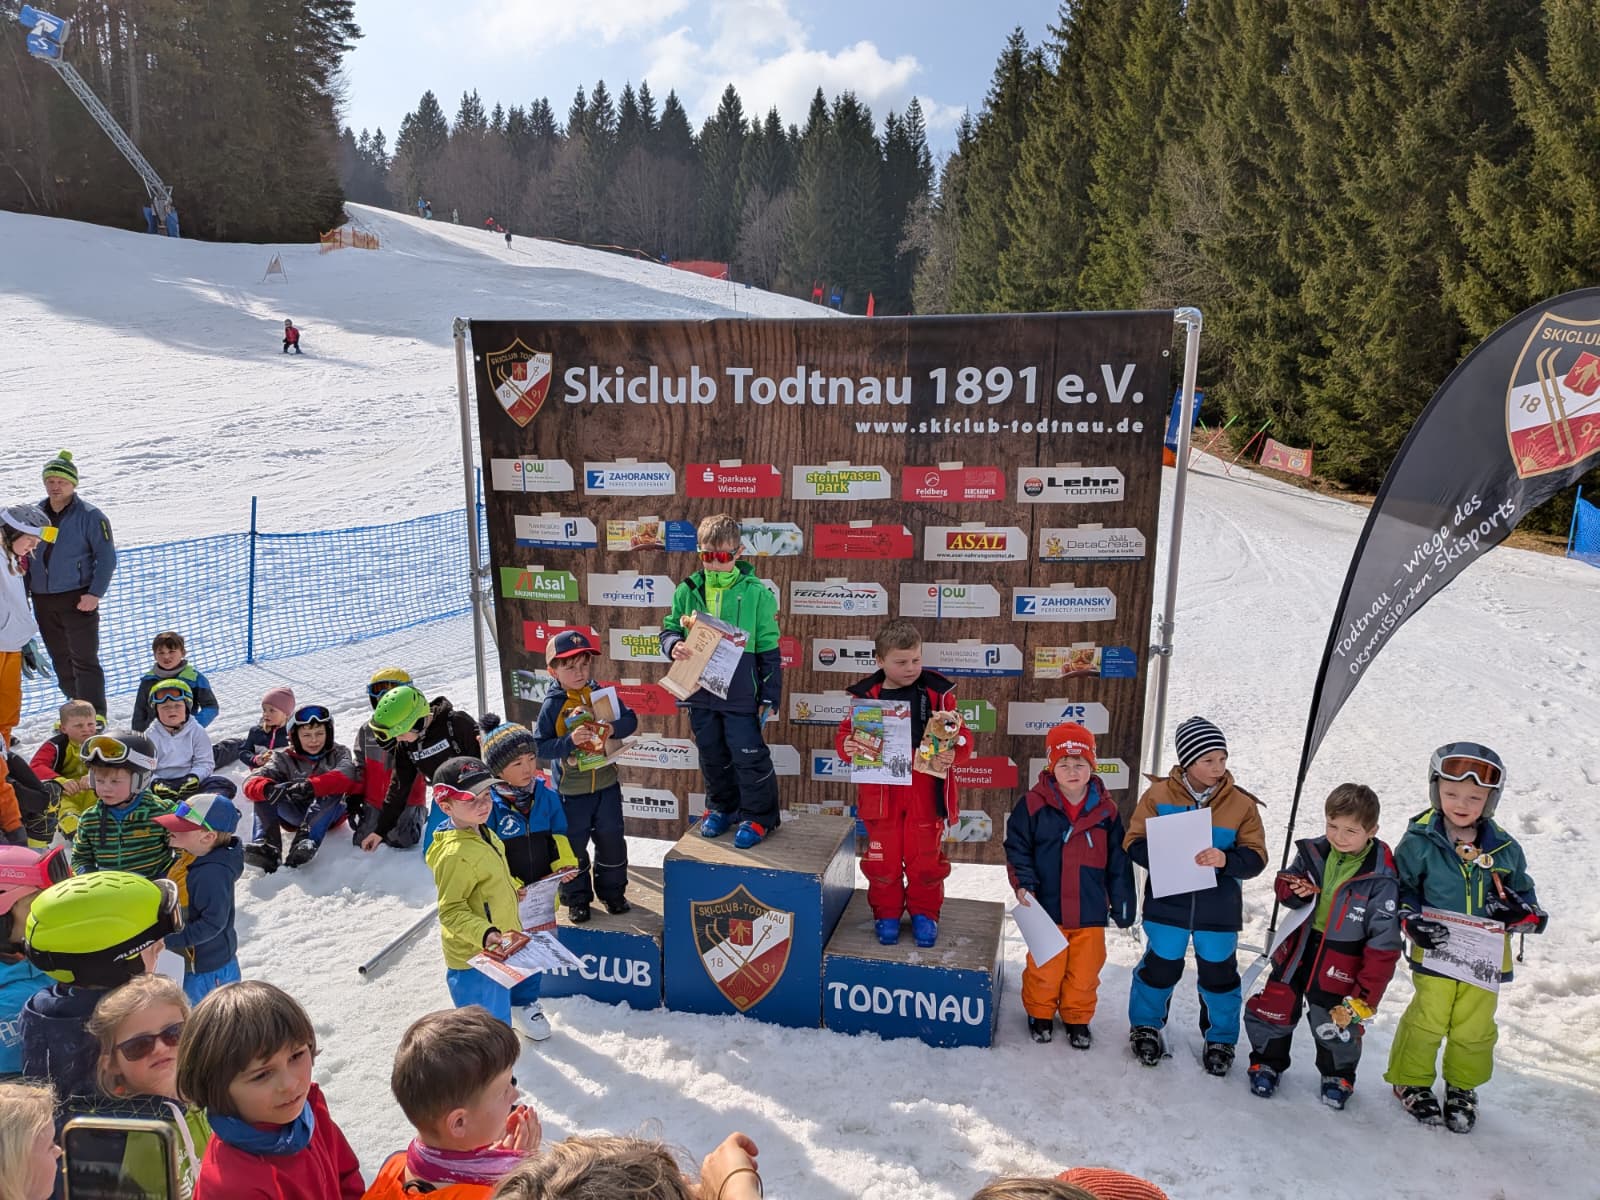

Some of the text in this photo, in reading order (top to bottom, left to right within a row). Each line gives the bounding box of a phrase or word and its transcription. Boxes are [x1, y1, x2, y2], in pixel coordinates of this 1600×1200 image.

[563, 363, 1145, 405] Skiclub Todtnau 1891 e.V.
[502, 389, 511, 399] 18
[1519, 393, 1542, 413] 18
[855, 417, 1145, 434] www.skiclub-todtnau.de
[608, 472, 671, 481] ZAHORANSKY
[717, 474, 757, 484] Sparkasse
[1047, 476, 1119, 487] Lehr
[717, 485, 757, 493] Wiesental
[815, 481, 849, 495] park
[915, 488, 948, 497] Feldberg
[949, 533, 1005, 549] ASAL
[1434, 497, 1516, 573] Skisports
[1066, 540, 1143, 549] DataCreate
[1335, 592, 1391, 658] Todtnau
[1454, 494, 1482, 527] des
[534, 575, 565, 591] Asal
[602, 591, 645, 603] engineering
[793, 591, 878, 599] TEICHMANN
[1041, 597, 1112, 606] ZAHORANSKY
[630, 644, 661, 657] park
[952, 766, 993, 774] Sparkasse
[631, 804, 675, 814] TODTNAU
[710, 957, 776, 975] 18 91
[827, 981, 985, 1026] TODTNAU
